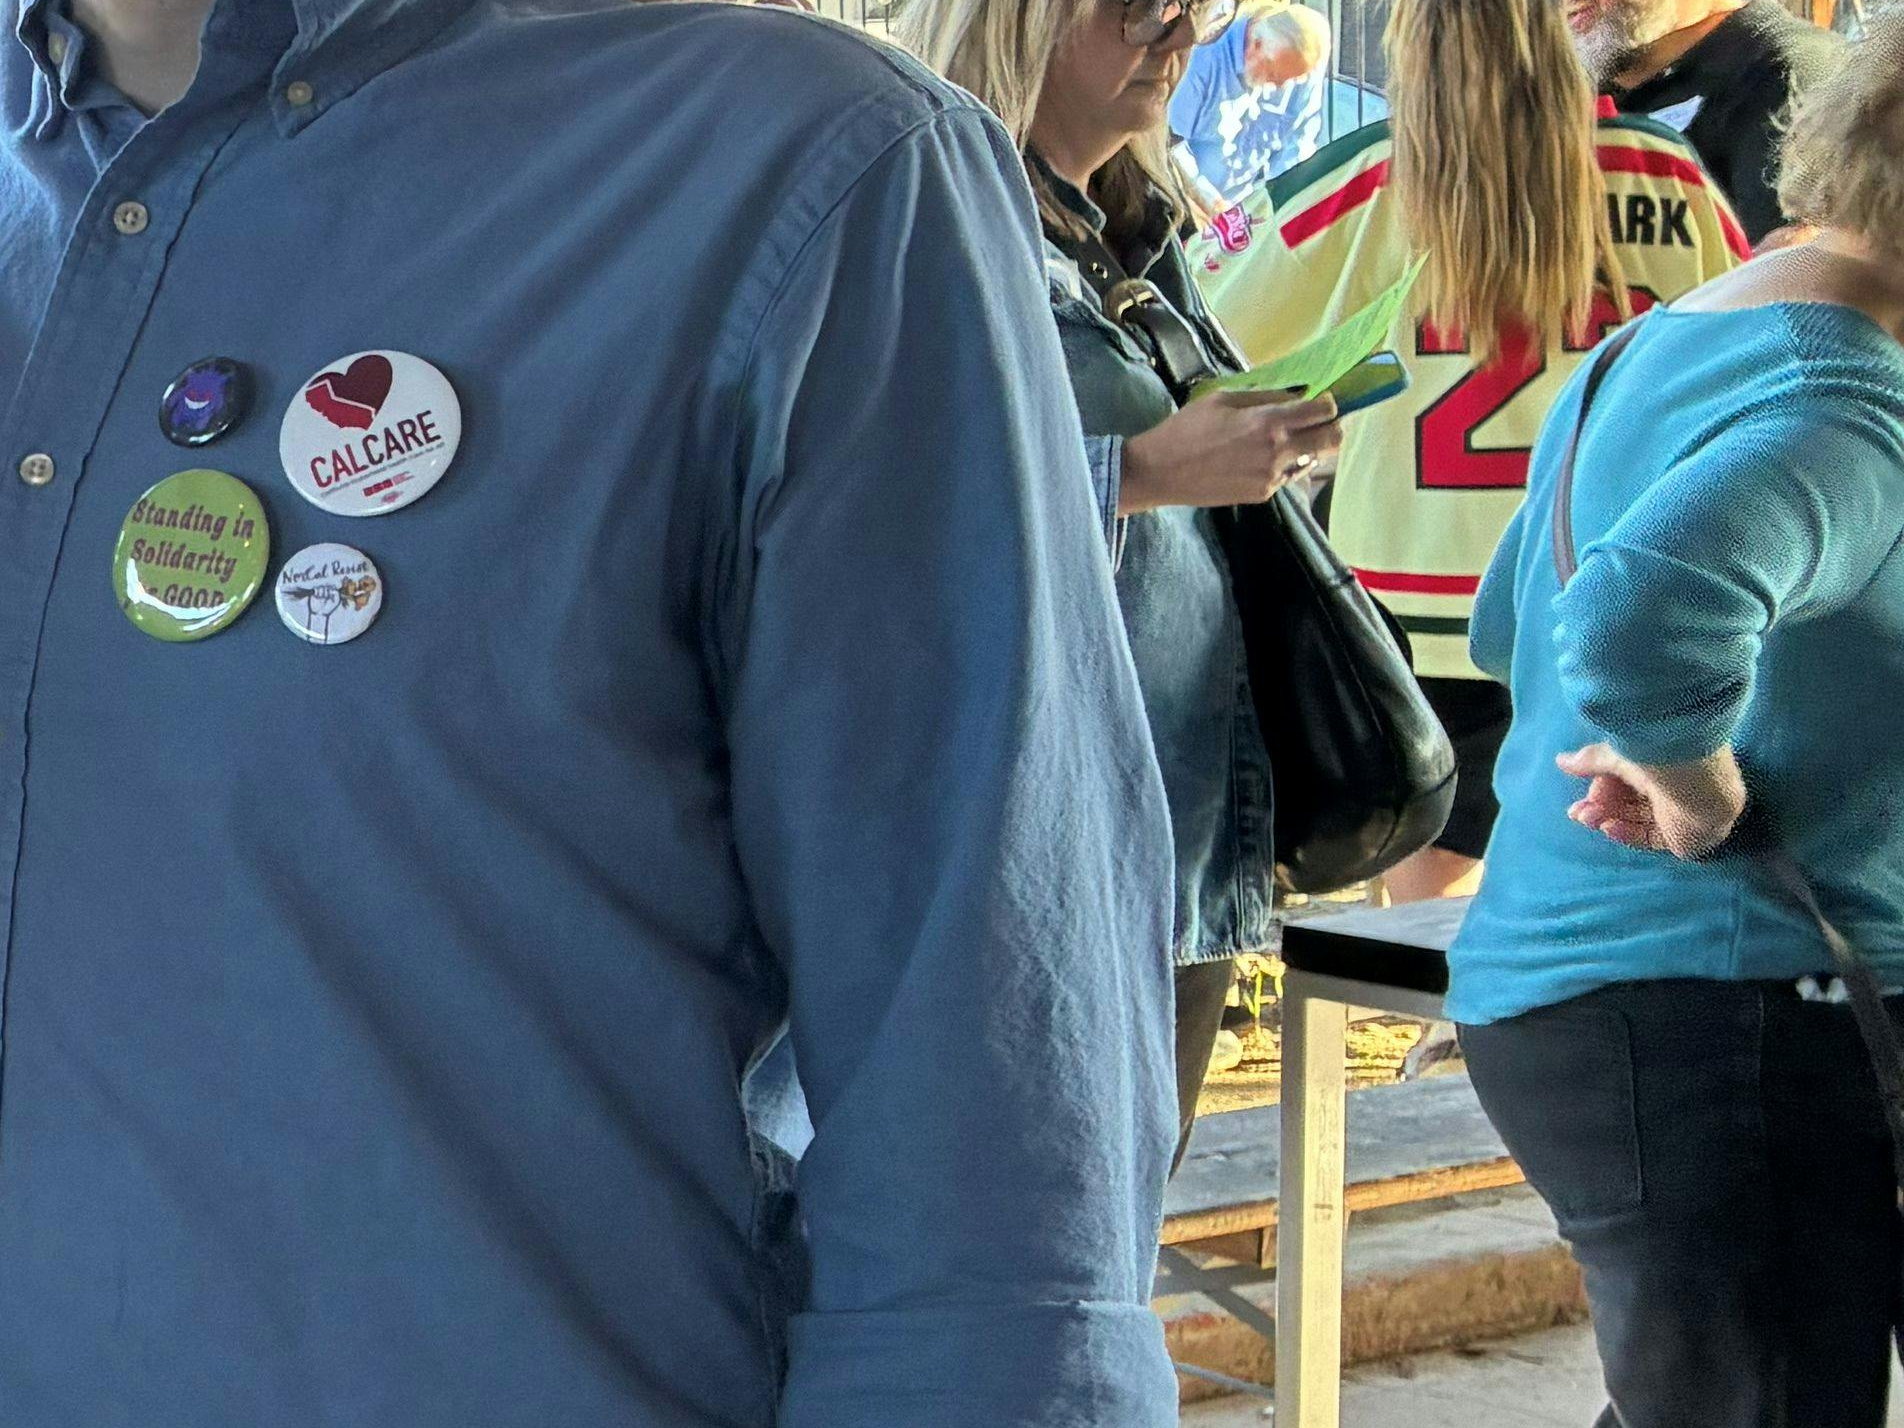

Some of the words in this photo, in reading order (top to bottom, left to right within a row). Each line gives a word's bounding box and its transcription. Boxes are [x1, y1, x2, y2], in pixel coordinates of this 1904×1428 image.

[310, 410, 441, 488] CALCARE
[132, 498, 227, 541] Standing
[232, 510, 255, 539] in
[132, 538, 238, 584] Solidarity
